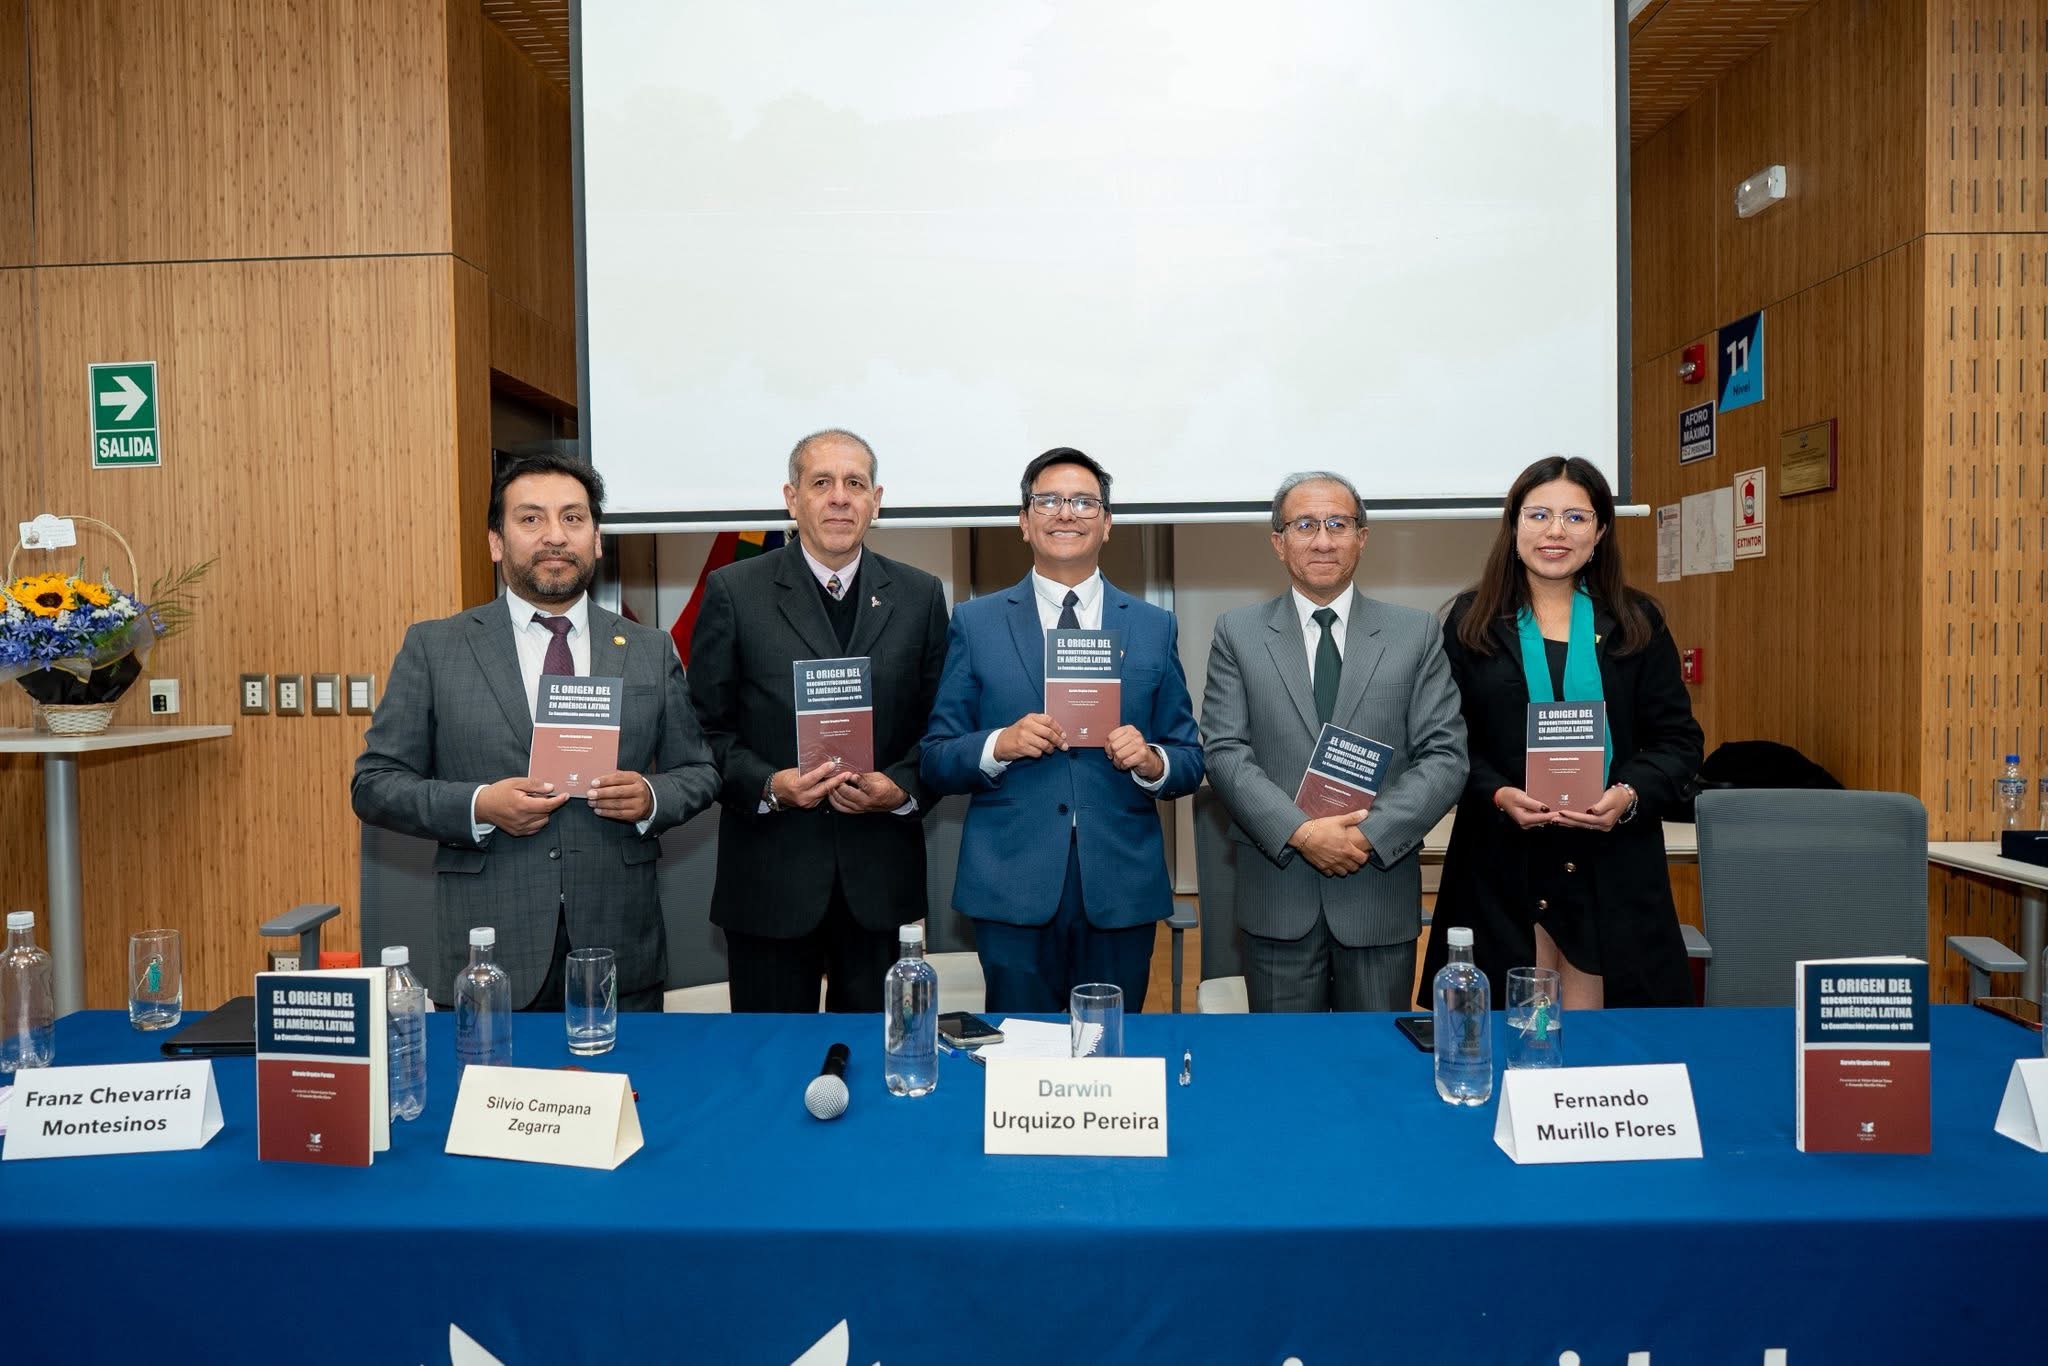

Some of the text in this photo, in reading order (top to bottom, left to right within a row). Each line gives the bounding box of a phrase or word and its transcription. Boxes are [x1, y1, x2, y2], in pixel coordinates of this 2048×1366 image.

[1727, 336, 1748, 376] 11
[1734, 383, 1750, 396] Nivel
[1685, 409, 1708, 427] AFORO
[1683, 424, 1710, 443] MÁXIMO
[100, 436, 154, 458] SALIDA
[1737, 536, 1761, 548] EXTINTOR
[1058, 639, 1111, 648] EL ORIGEN DEL
[806, 668, 861, 679] EL ORIGEN DEL
[550, 685, 611, 695] EL ORIGEN DEL
[815, 686, 841, 695] AMÉRICA
[1539, 709, 1593, 719] EL ORIGEN DEL
[1330, 736, 1380, 761] EL ORIGEN DEL
[1332, 754, 1356, 768] AMÉRICA
[1356, 764, 1375, 775] LATINA
[1821, 978, 1912, 993] EL ORIGEN DEL
[273, 990, 354, 1007] EL ORIGEN DEL
[1821, 996, 1912, 1005] NEOCONSTITUCIONALISMO
[273, 1008, 354, 1019] NEOCONSTITUCIONALISMO
[1821, 1006, 1912, 1018] EN AMÉRICA LATINA
[273, 1017, 354, 1032] EN AMÉRICA LATINA
[25, 1084, 191, 1107] Franz Chevarría
[1039, 1080, 1112, 1097] Darwin
[487, 1096, 591, 1116] Silvio Campana
[1554, 1089, 1649, 1108] Fernando
[42, 1116, 167, 1136] Montesinos
[508, 1118, 561, 1135] Zegarra
[993, 1111, 1159, 1133] Urquizo Pereira
[1537, 1120, 1676, 1140] Murillo Flores
